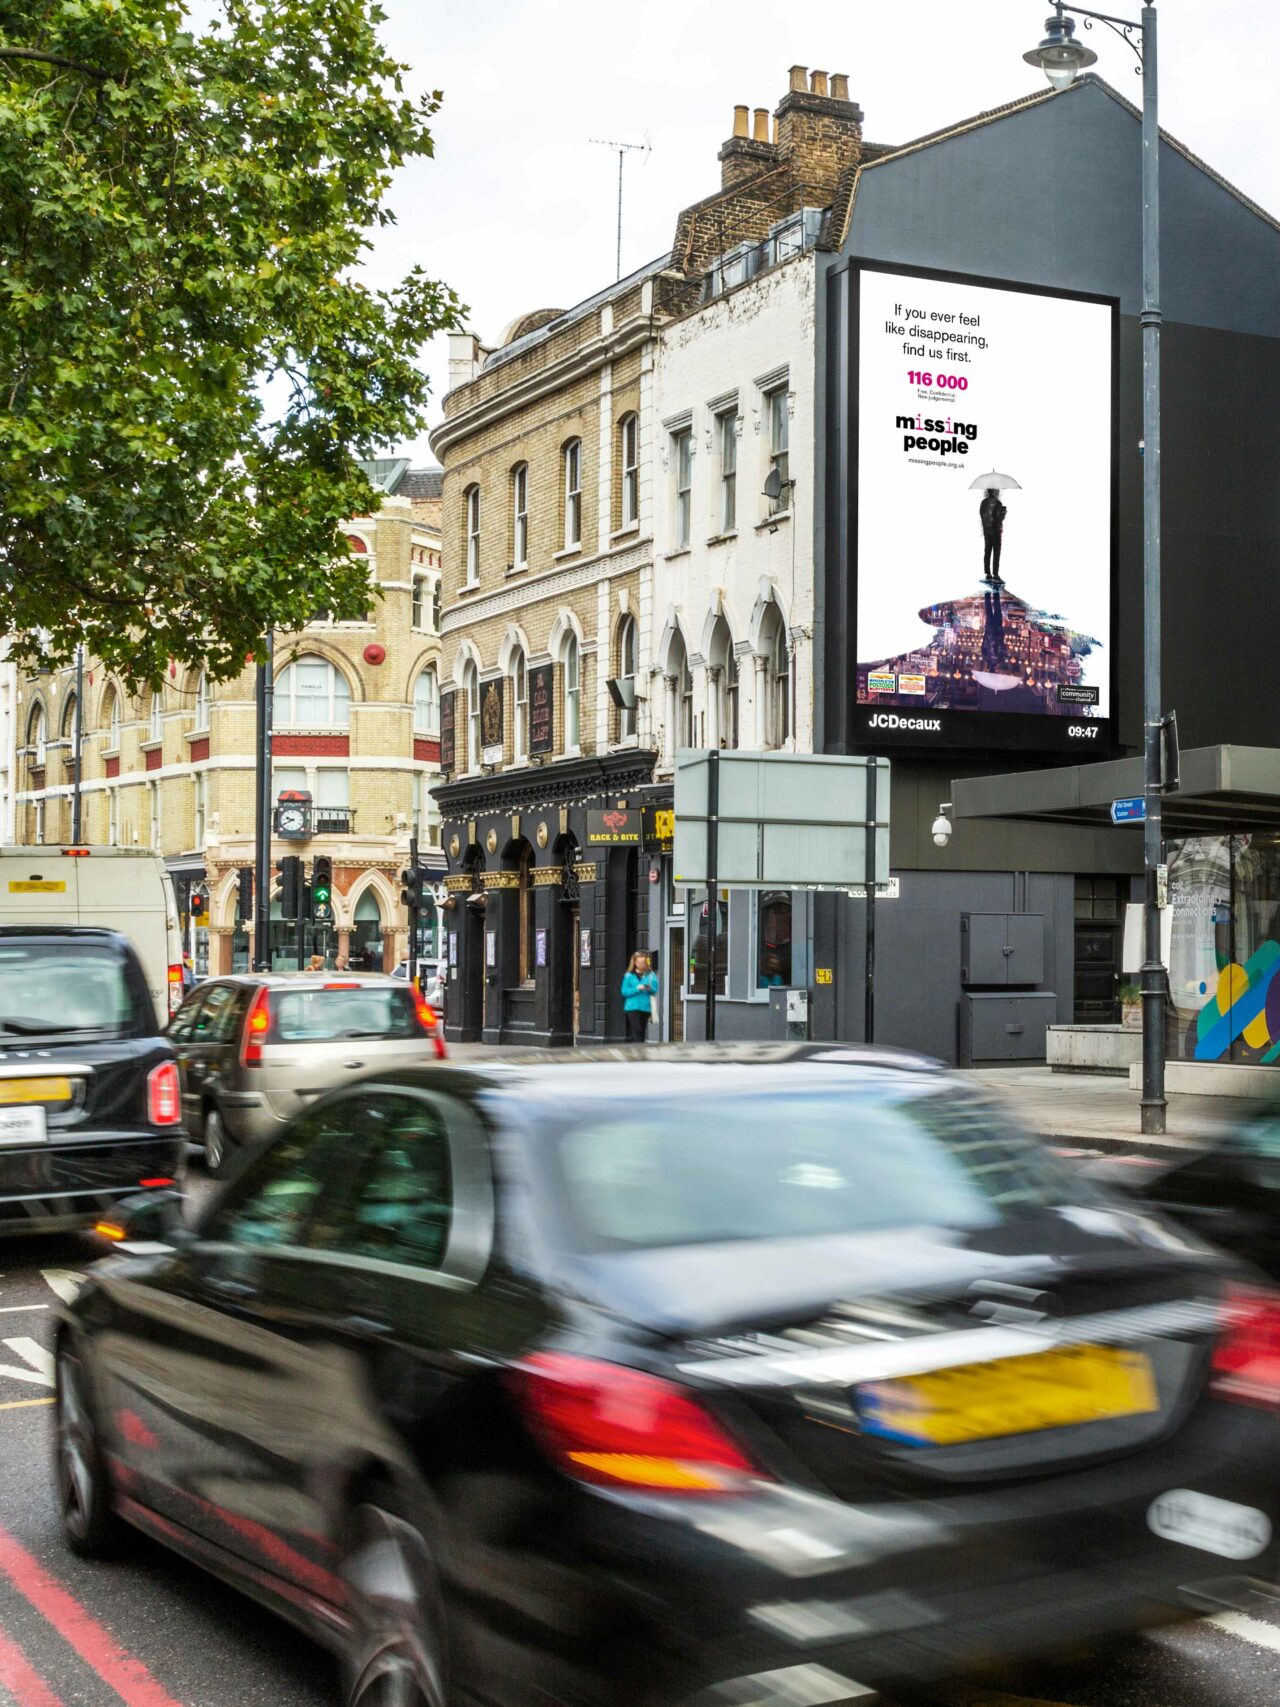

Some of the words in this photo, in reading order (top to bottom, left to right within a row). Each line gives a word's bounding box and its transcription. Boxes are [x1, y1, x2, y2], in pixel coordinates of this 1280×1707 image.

[894, 303, 902, 316] If
[905, 308, 926, 321] you
[930, 311, 956, 323] ever
[959, 312, 980, 327] feel
[885, 320, 906, 335] like
[908, 324, 989, 349] disappearing,
[902, 342, 925, 357] find
[928, 348, 943, 359] us
[946, 347, 972, 363] first.
[907, 370, 933, 386] 116
[936, 373, 968, 391] 000
[896, 413, 978, 440] missing
[903, 435, 969, 456] people
[1062, 690, 1095, 699] community
[868, 713, 941, 731] JCDecaux
[1068, 725, 1098, 738] 09:47
[621, 833, 639, 841] BITE
